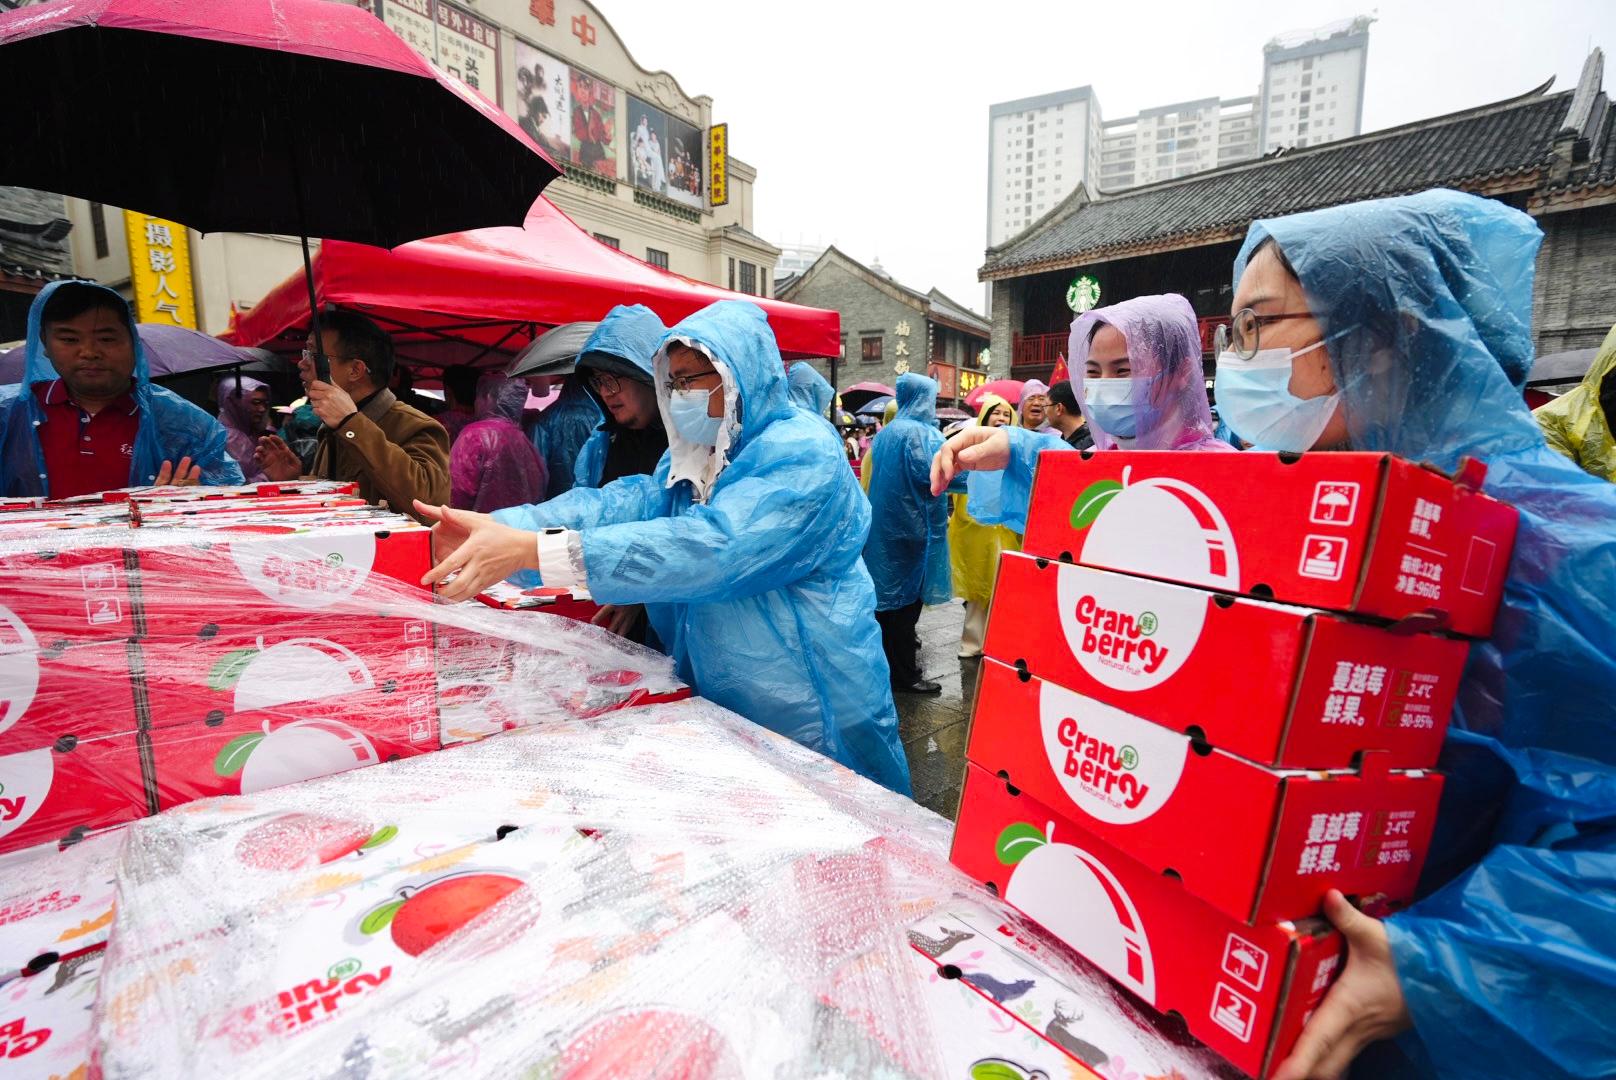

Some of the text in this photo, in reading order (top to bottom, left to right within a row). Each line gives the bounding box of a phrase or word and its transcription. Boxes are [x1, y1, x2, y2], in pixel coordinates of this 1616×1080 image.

[144, 216, 182, 324] 摄影人气
[1315, 541, 1333, 560] 2
[1075, 595, 1143, 639] Cran
[1082, 626, 1169, 674] berry
[1098, 655, 1125, 670] Natural
[1329, 661, 1387, 696] 蔓越莓
[1057, 717, 1124, 771] Cran
[1064, 749, 1150, 809] berry
[1227, 994, 1243, 1018] 2
